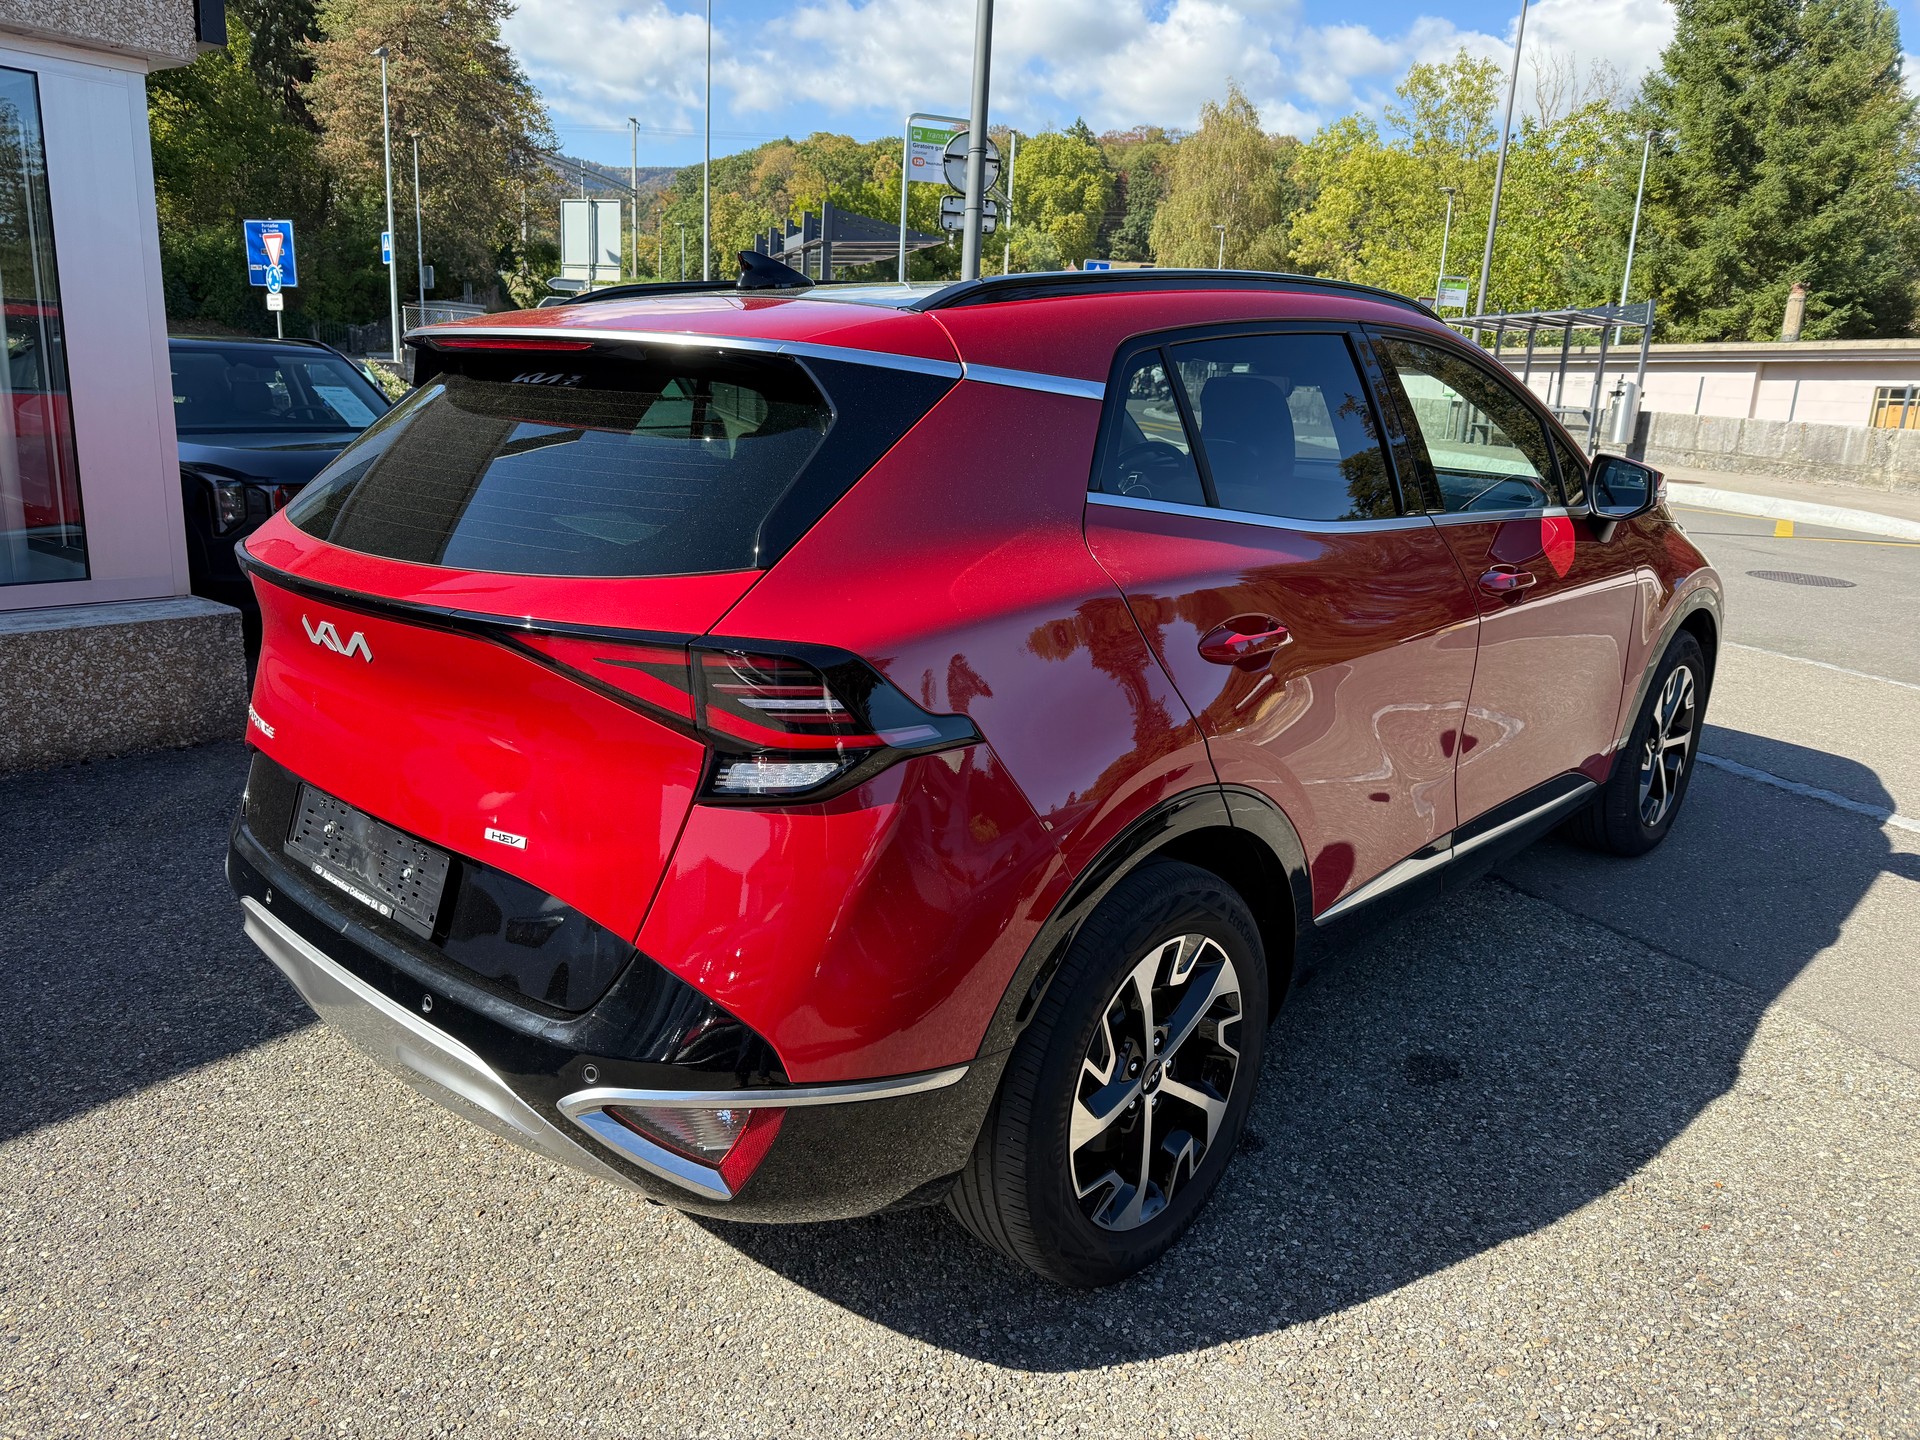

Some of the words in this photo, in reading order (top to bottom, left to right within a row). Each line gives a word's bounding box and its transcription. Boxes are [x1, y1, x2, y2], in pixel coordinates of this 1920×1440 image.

[302, 614, 373, 663] KIA
[491, 831, 521, 844] HEV
[370, 899, 378, 910] SA
